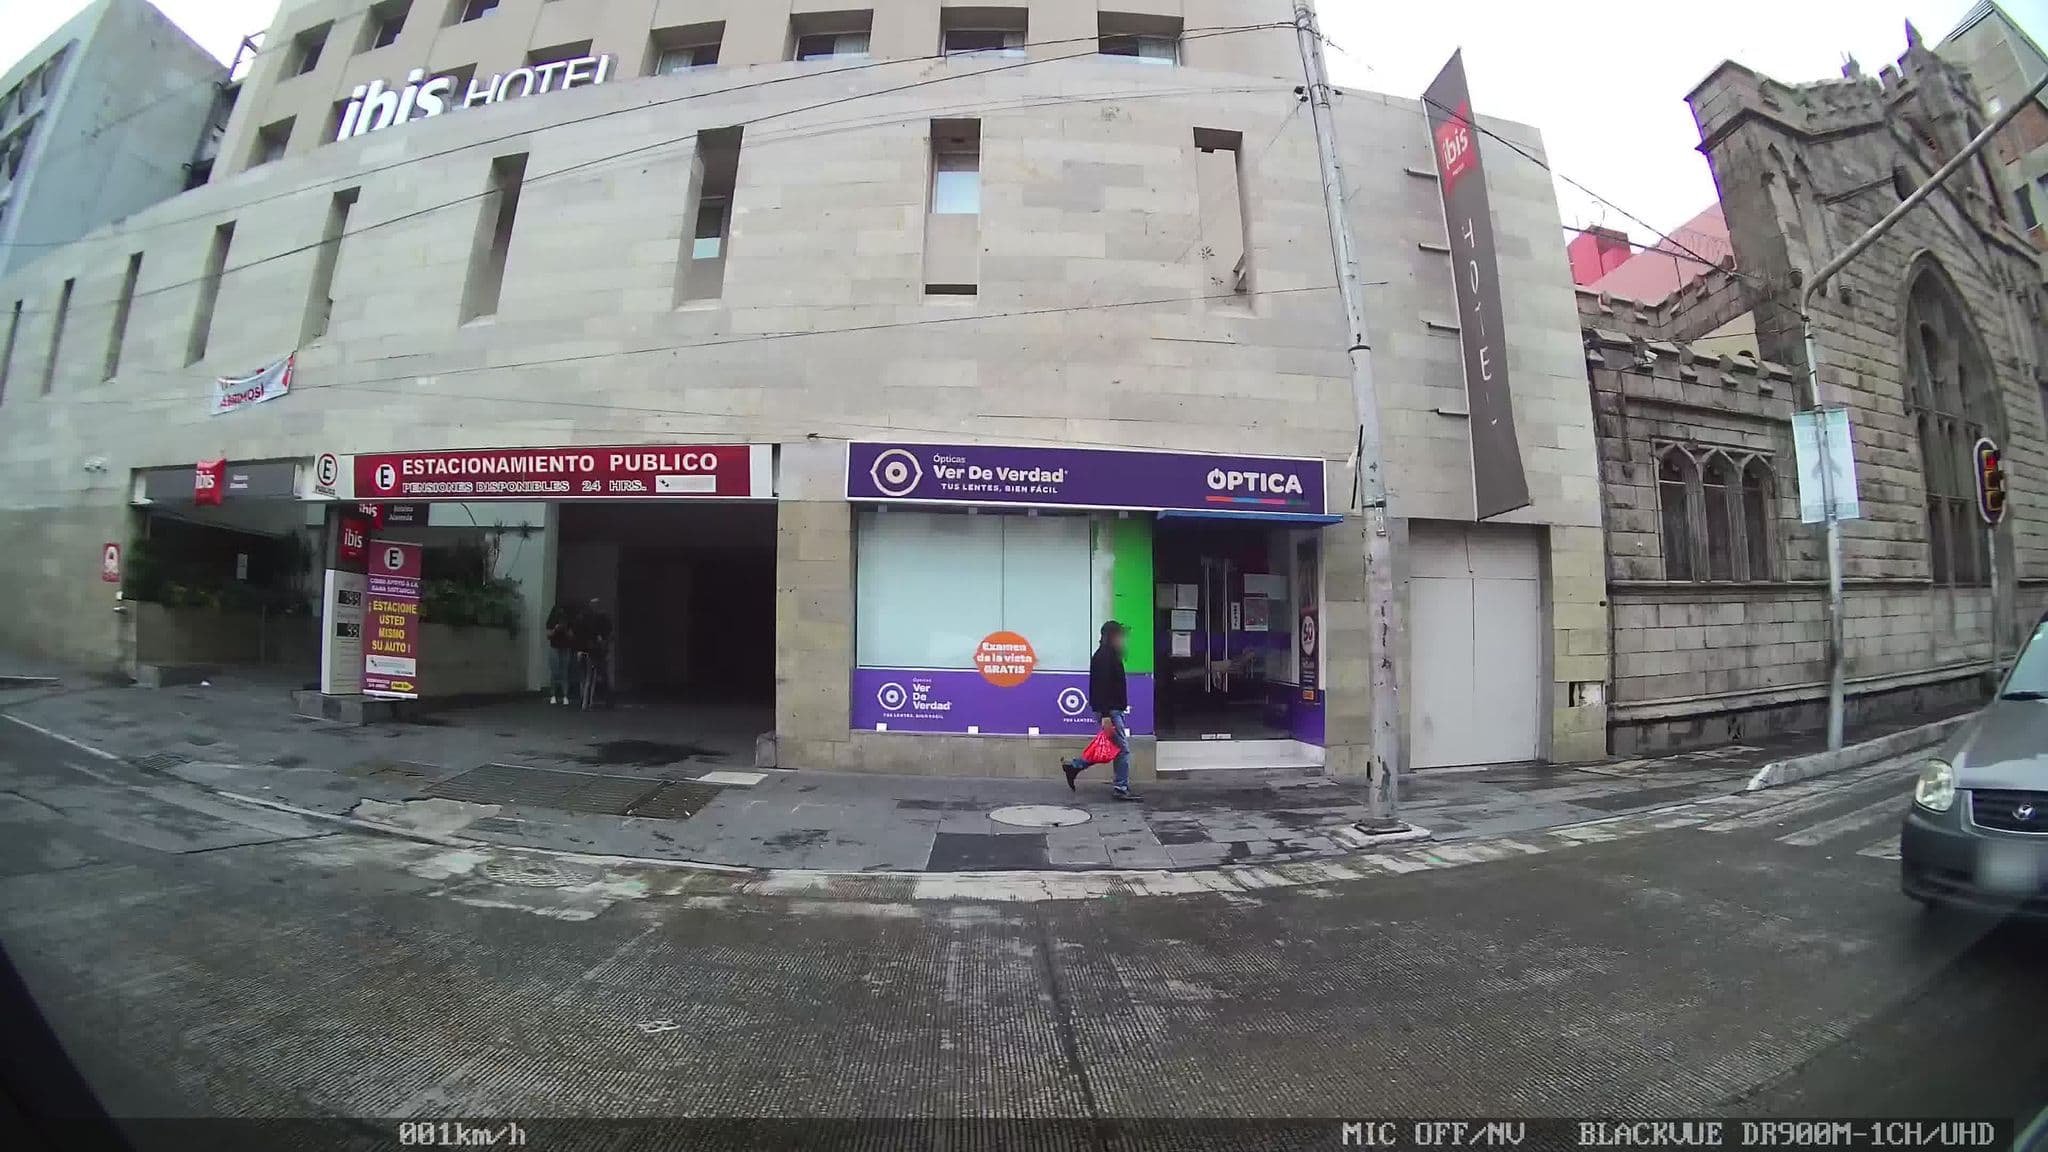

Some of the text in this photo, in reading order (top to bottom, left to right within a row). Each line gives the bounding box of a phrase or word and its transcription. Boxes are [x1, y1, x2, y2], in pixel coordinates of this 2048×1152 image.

[336, 68, 451, 142] ibis
[1441, 128, 1468, 170] ibis
[322, 459, 333, 480] E
[402, 453, 718, 475] ESTACIONAMIENTO PUBLICO
[380, 466, 390, 488] E
[933, 465, 1064, 483] Ver De Verdad
[402, 480, 648, 493] PENSIONES DISPONIBLES 24 HRS.
[1206, 468, 1303, 494] ÓPTICA
[1005, 485, 1028, 493] BIEN
[344, 528, 362, 548] ibis
[389, 549, 399, 567] E
[379, 615, 405, 626] USTED
[378, 627, 405, 640] MISMO
[371, 639, 383, 650] SU
[982, 642, 1027, 651] Examen
[976, 653, 1033, 663] de la vista
[984, 665, 1026, 674] GRATIS
[912, 683, 931, 692] Ver
[912, 692, 927, 701] De
[912, 701, 951, 711] Verdad
